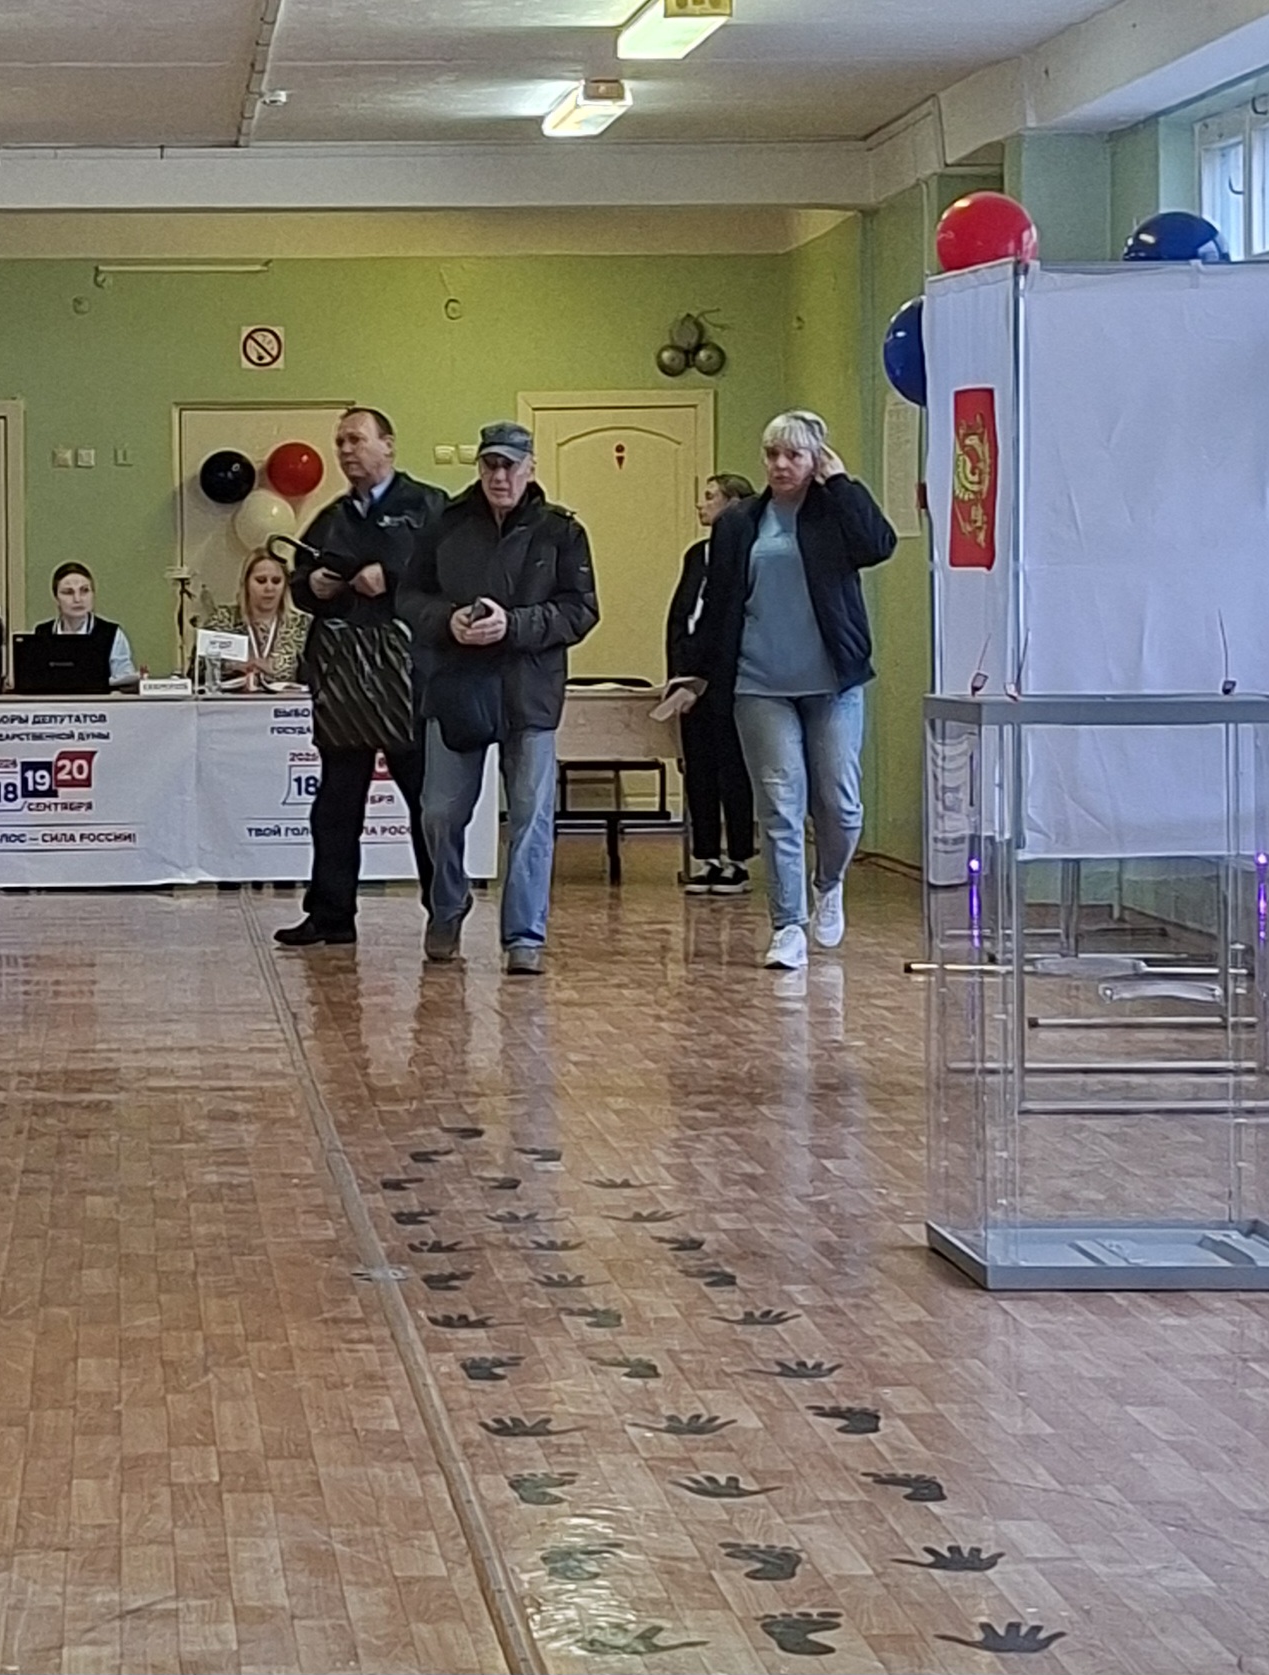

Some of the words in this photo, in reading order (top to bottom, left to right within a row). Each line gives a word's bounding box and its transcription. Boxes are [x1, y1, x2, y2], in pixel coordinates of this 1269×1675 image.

[31, 713, 108, 725] ДЕПУТАТОВ
[273, 708, 311, 718] ВЫБО
[77, 731, 110, 742] ДУМЫ
[56, 759, 89, 780] 20
[24, 769, 51, 791] 19
[293, 775, 319, 797] 18
[27, 802, 93, 812] СЕНТЯБРЯ
[246, 825, 281, 837] ТВОЙ
[41, 833, 76, 843] СИЛА
[80, 832, 137, 843] РОССИИ!
